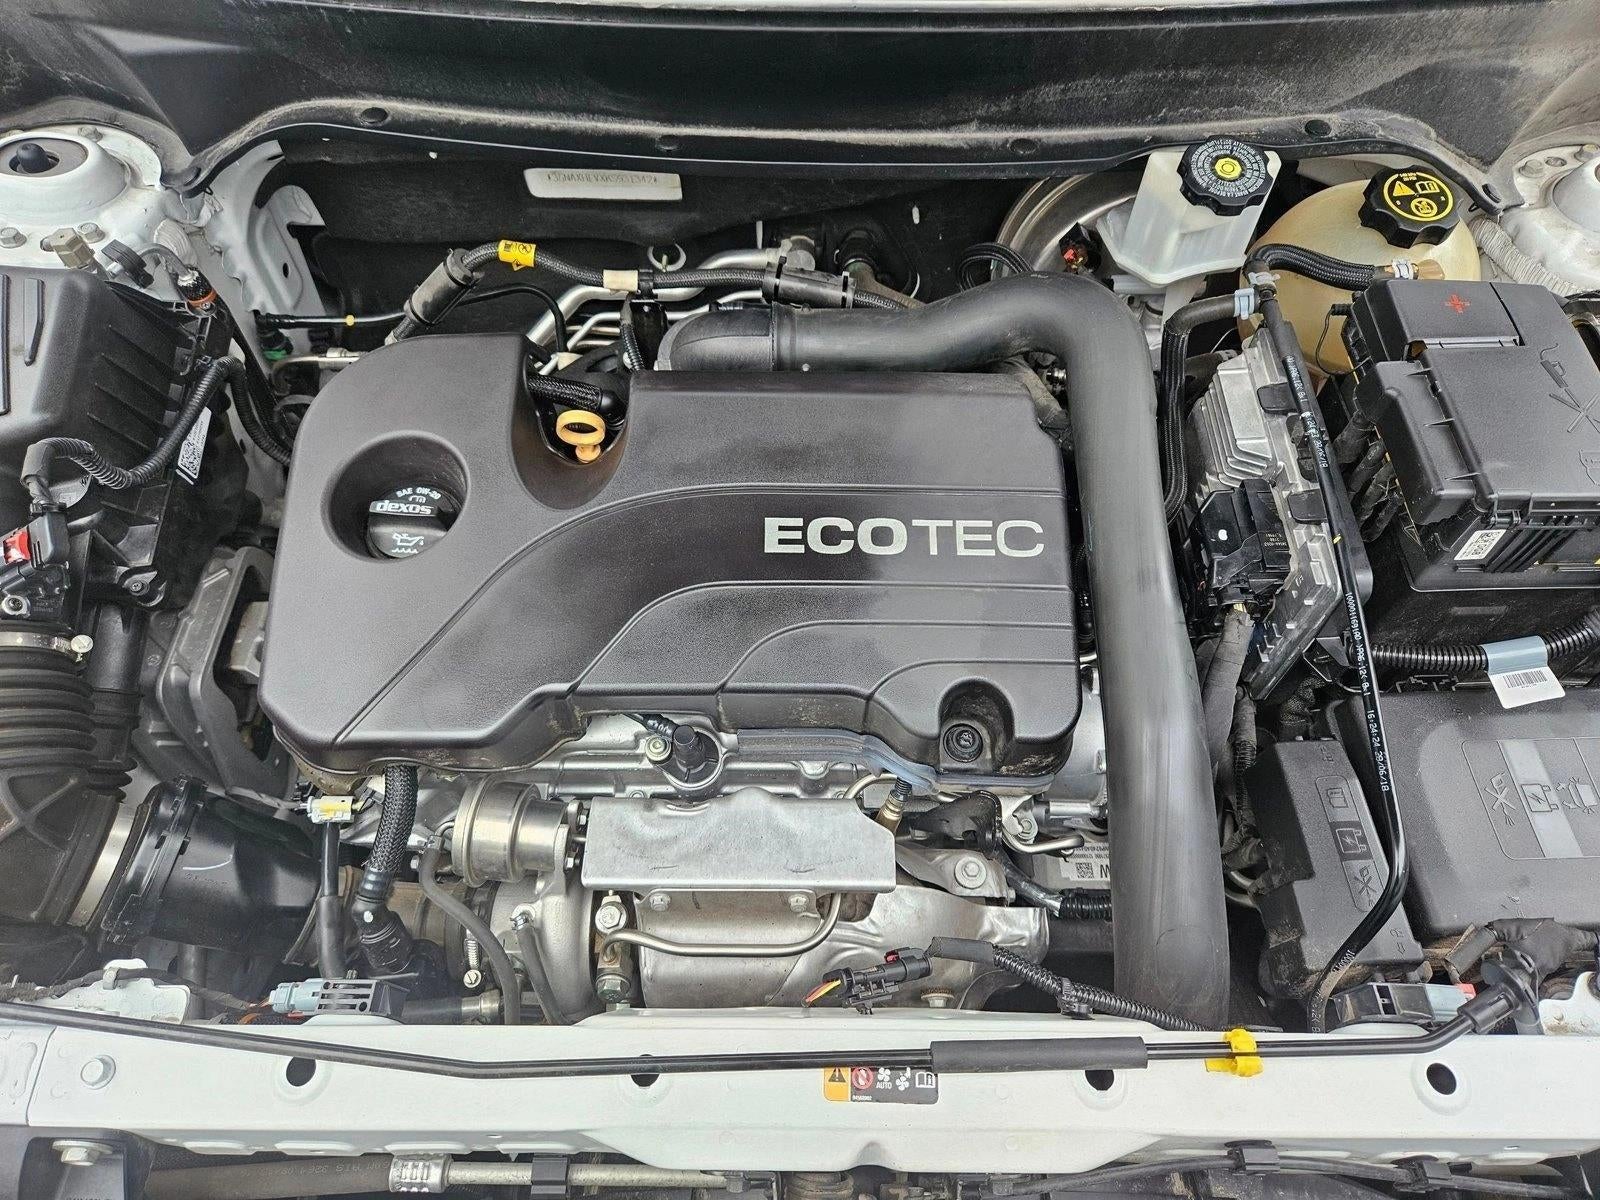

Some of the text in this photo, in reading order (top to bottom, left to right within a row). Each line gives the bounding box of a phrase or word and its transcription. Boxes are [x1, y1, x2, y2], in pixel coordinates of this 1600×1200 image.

[376, 500, 434, 515] dexos
[764, 517, 1045, 558] ECOTEC
[876, 1081, 893, 1089] AUTO
